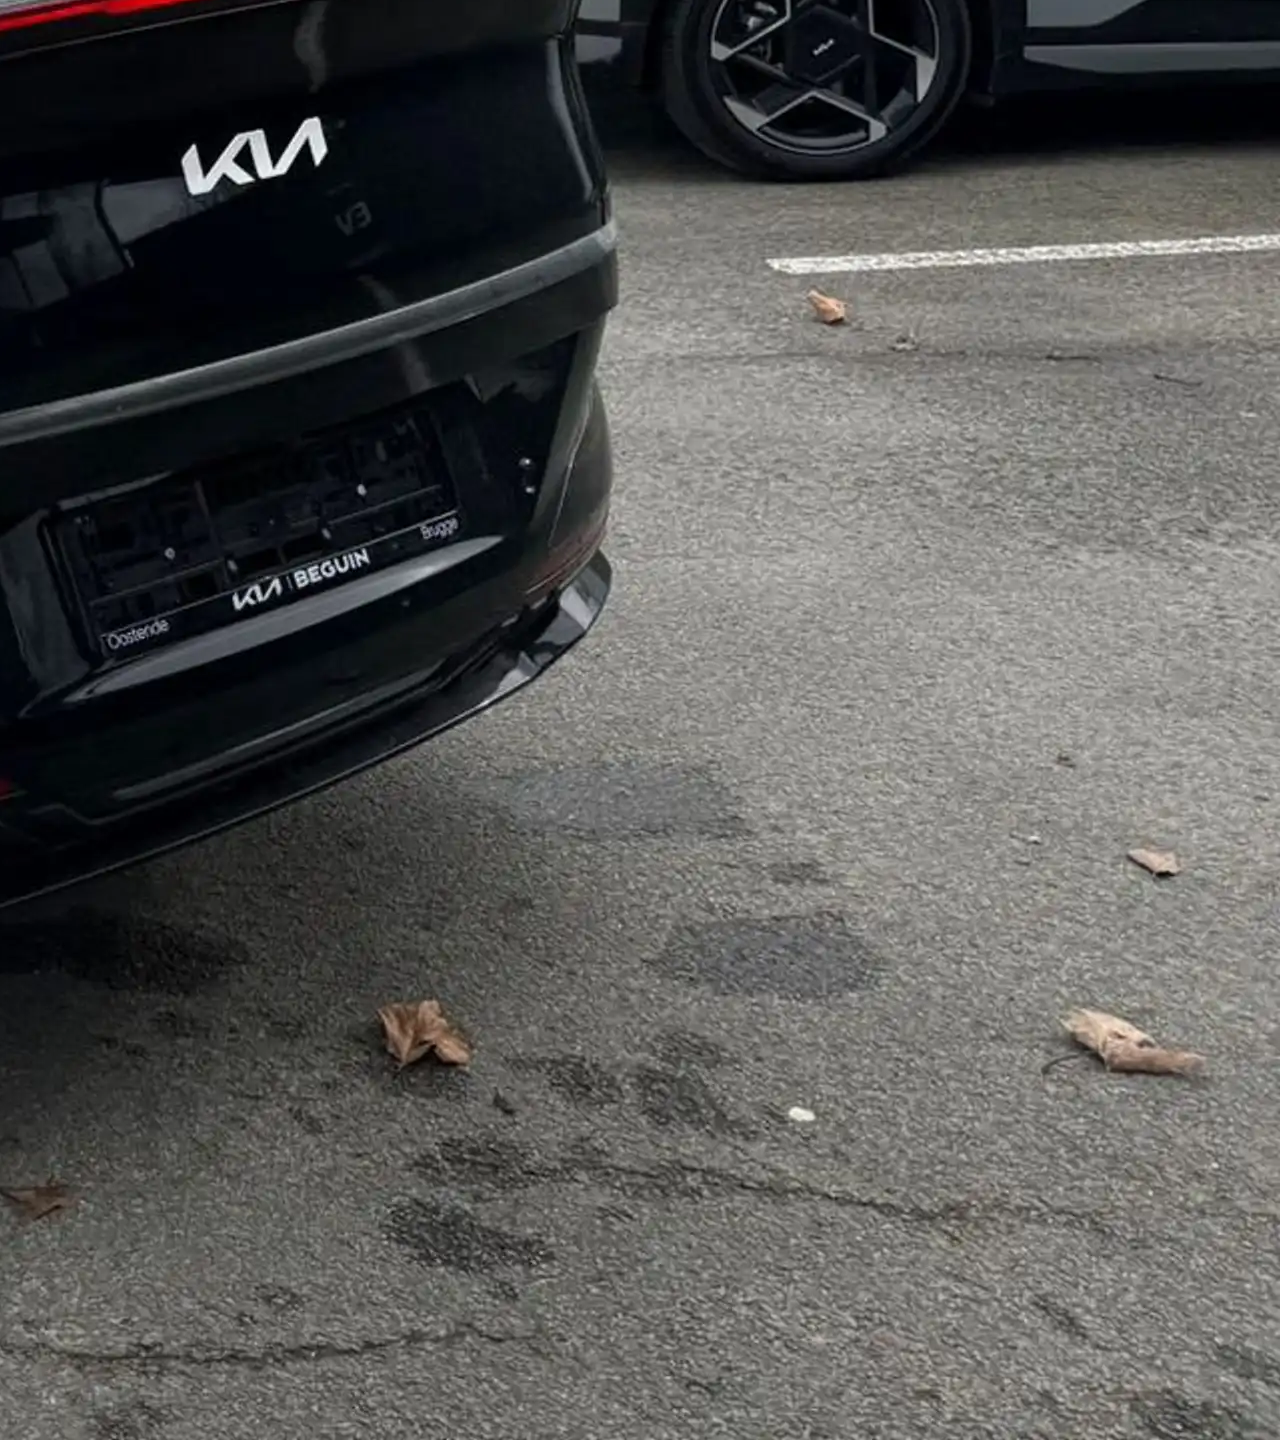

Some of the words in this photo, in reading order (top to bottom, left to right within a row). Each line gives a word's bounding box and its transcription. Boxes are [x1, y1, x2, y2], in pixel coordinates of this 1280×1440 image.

[181, 116, 328, 196] KIA
[420, 516, 460, 541] Brugge
[107, 618, 171, 650] Oostende
[231, 577, 283, 611] KIA
[293, 547, 371, 589] BEGUIN
